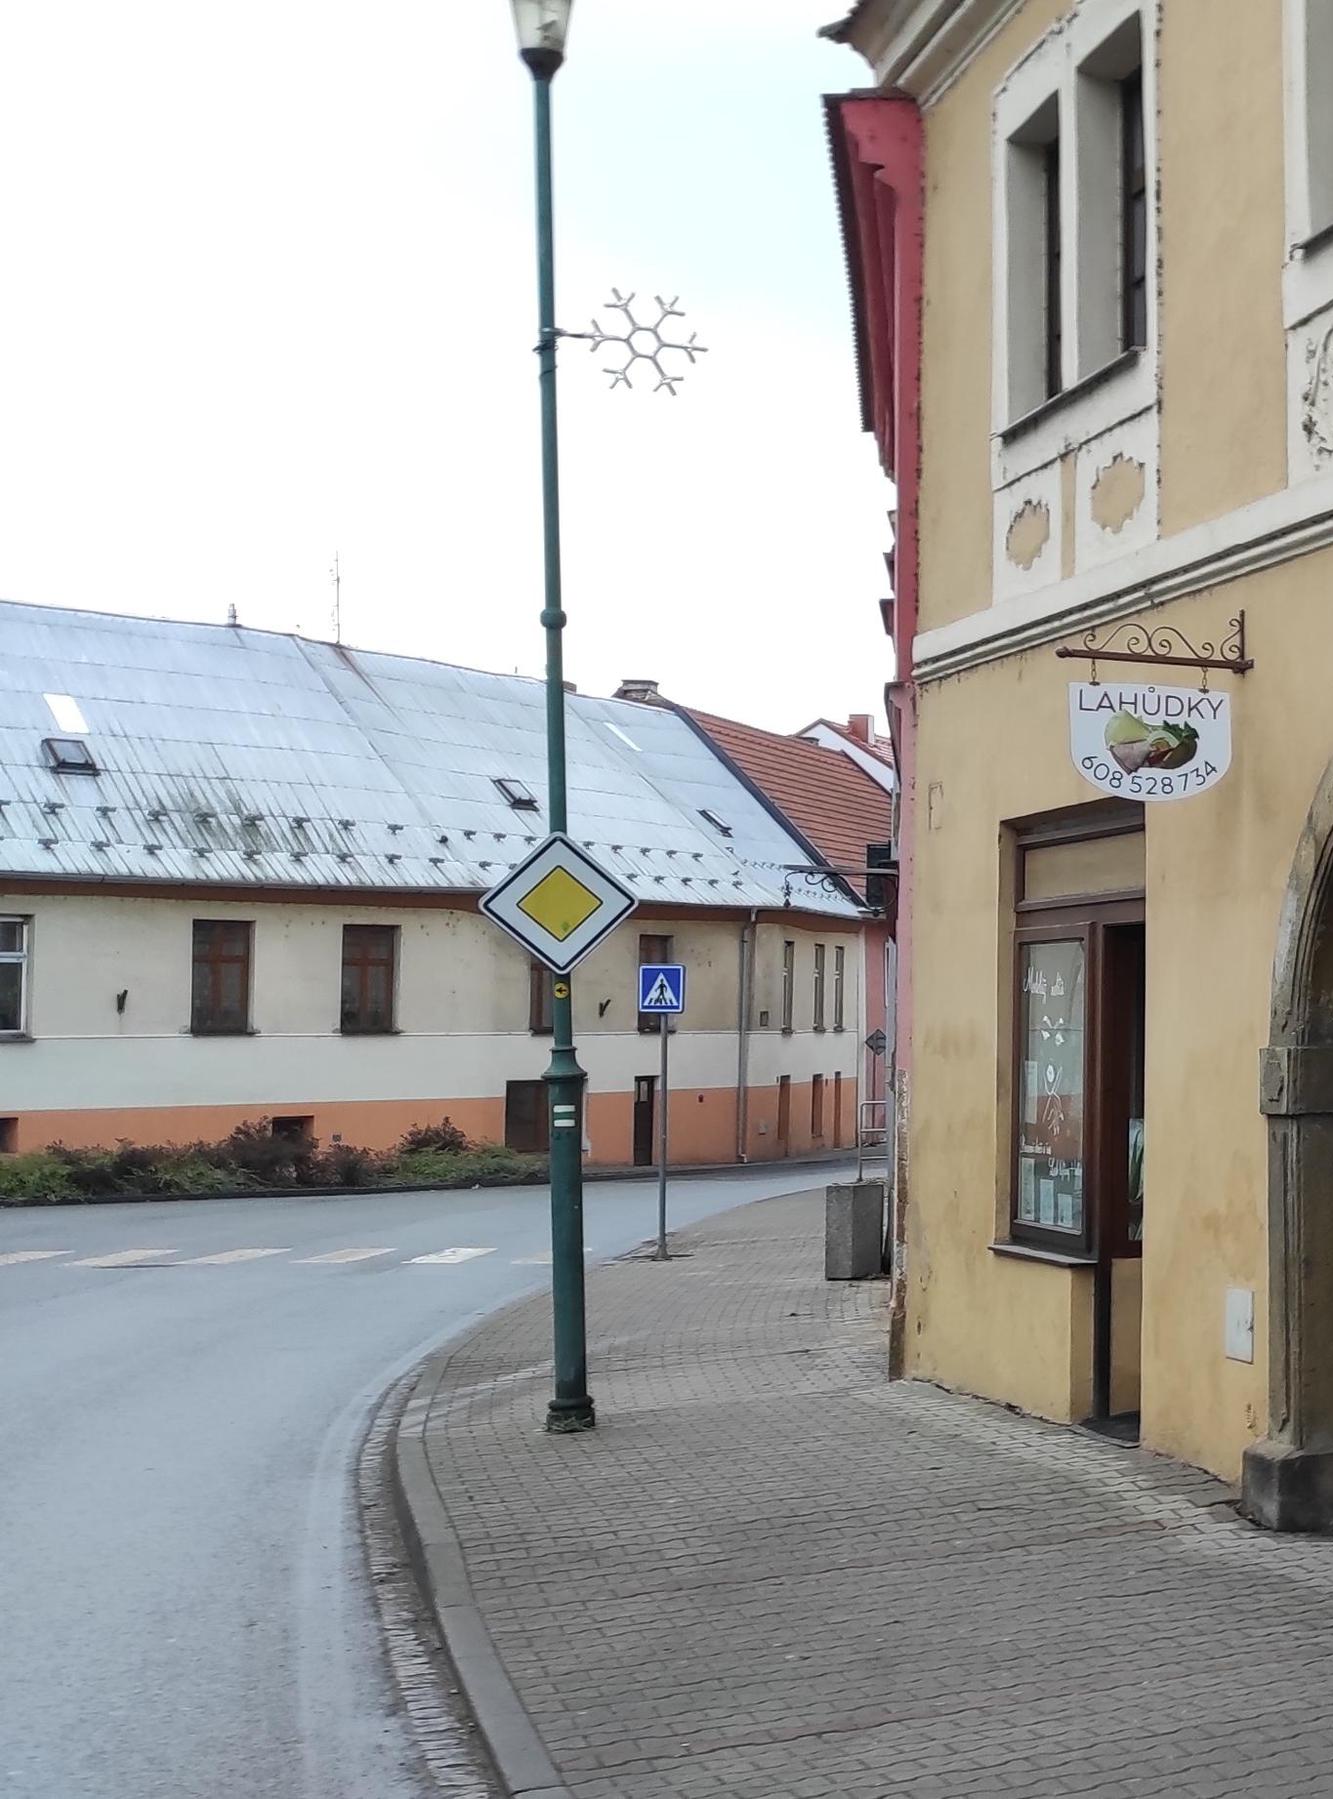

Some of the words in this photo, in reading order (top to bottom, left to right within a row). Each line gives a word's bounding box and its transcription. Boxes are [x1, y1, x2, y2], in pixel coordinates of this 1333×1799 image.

[1078, 686, 1225, 720] LAHŮDKY
[1081, 755, 1124, 789] 608
[1129, 775, 1174, 795] 528
[1178, 760, 1218, 792] 734
